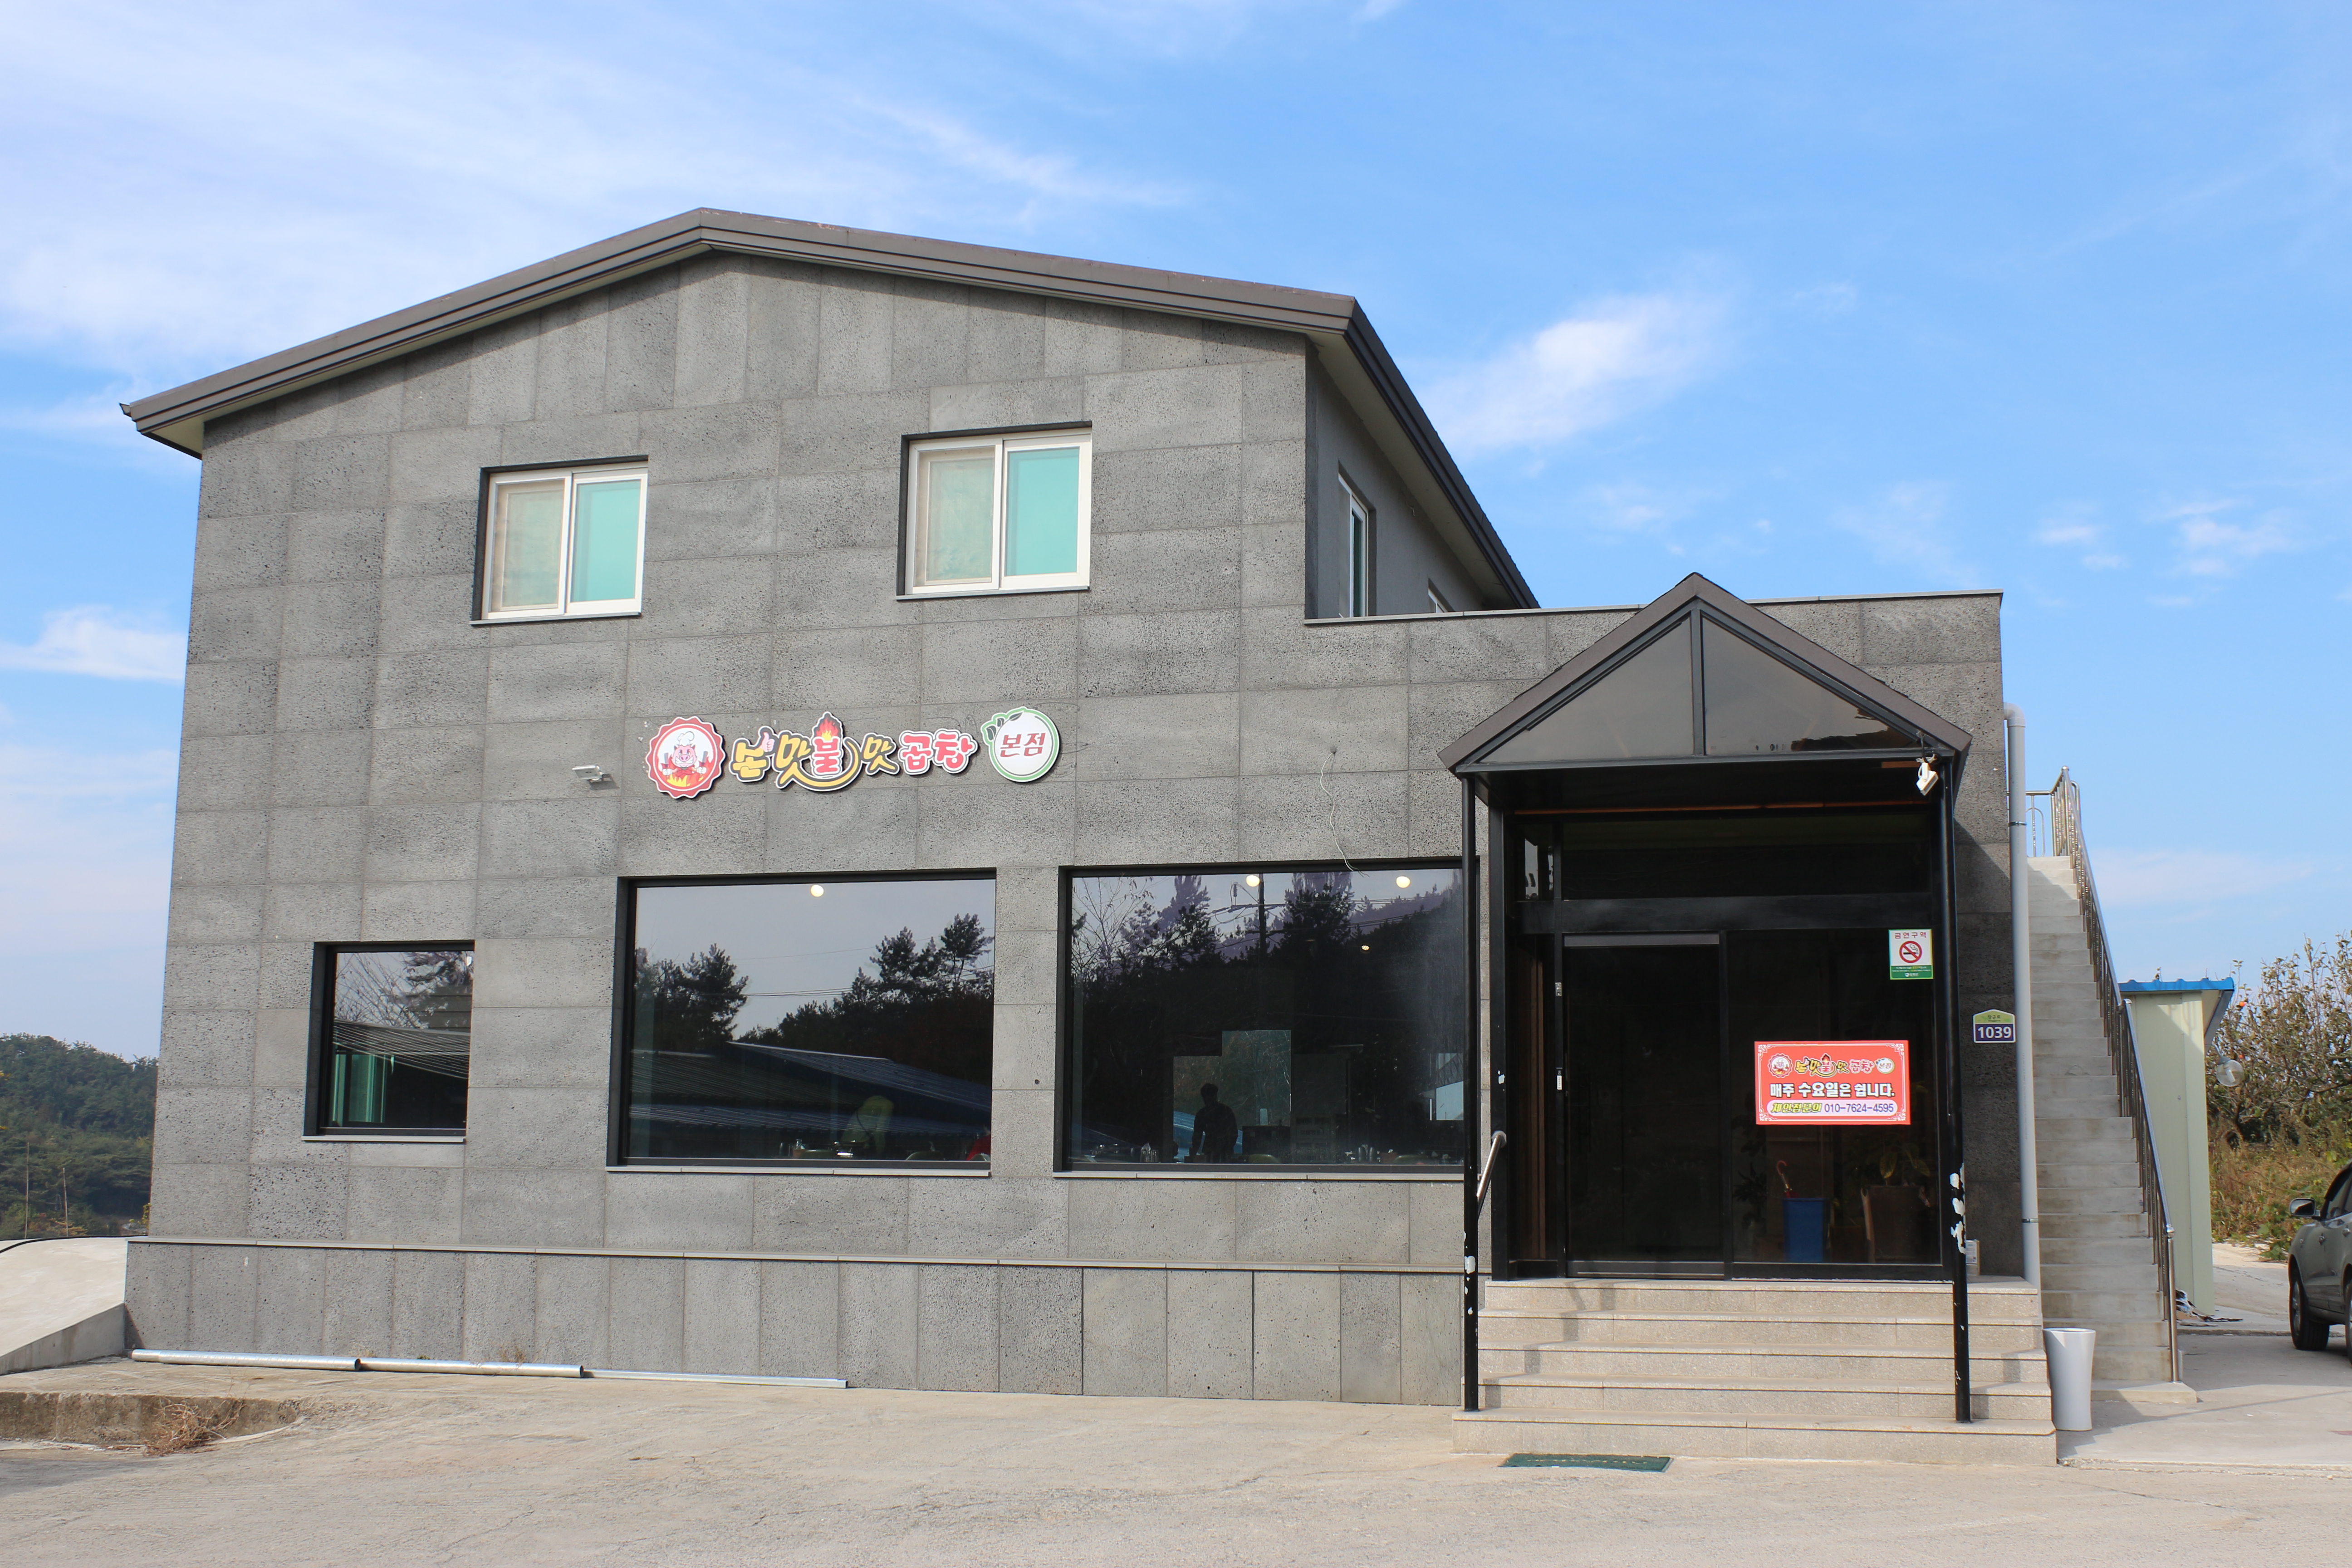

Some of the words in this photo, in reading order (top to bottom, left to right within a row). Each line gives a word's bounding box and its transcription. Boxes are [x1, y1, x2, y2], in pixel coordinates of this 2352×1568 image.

[900, 730, 976, 773] 곱창
[1000, 732, 1045, 758] 본점
[1978, 1026, 2012, 1039] 1039
[1850, 1060, 1874, 1073] 곱창
[1770, 1083, 1795, 1098] 매주
[1798, 1082, 1852, 1098] 수요일은
[1854, 1083, 1896, 1097] 쉽니다.
[1771, 1102, 1823, 1113] 체인점문의
[1824, 1103, 1894, 1112] 010-7624-4595
